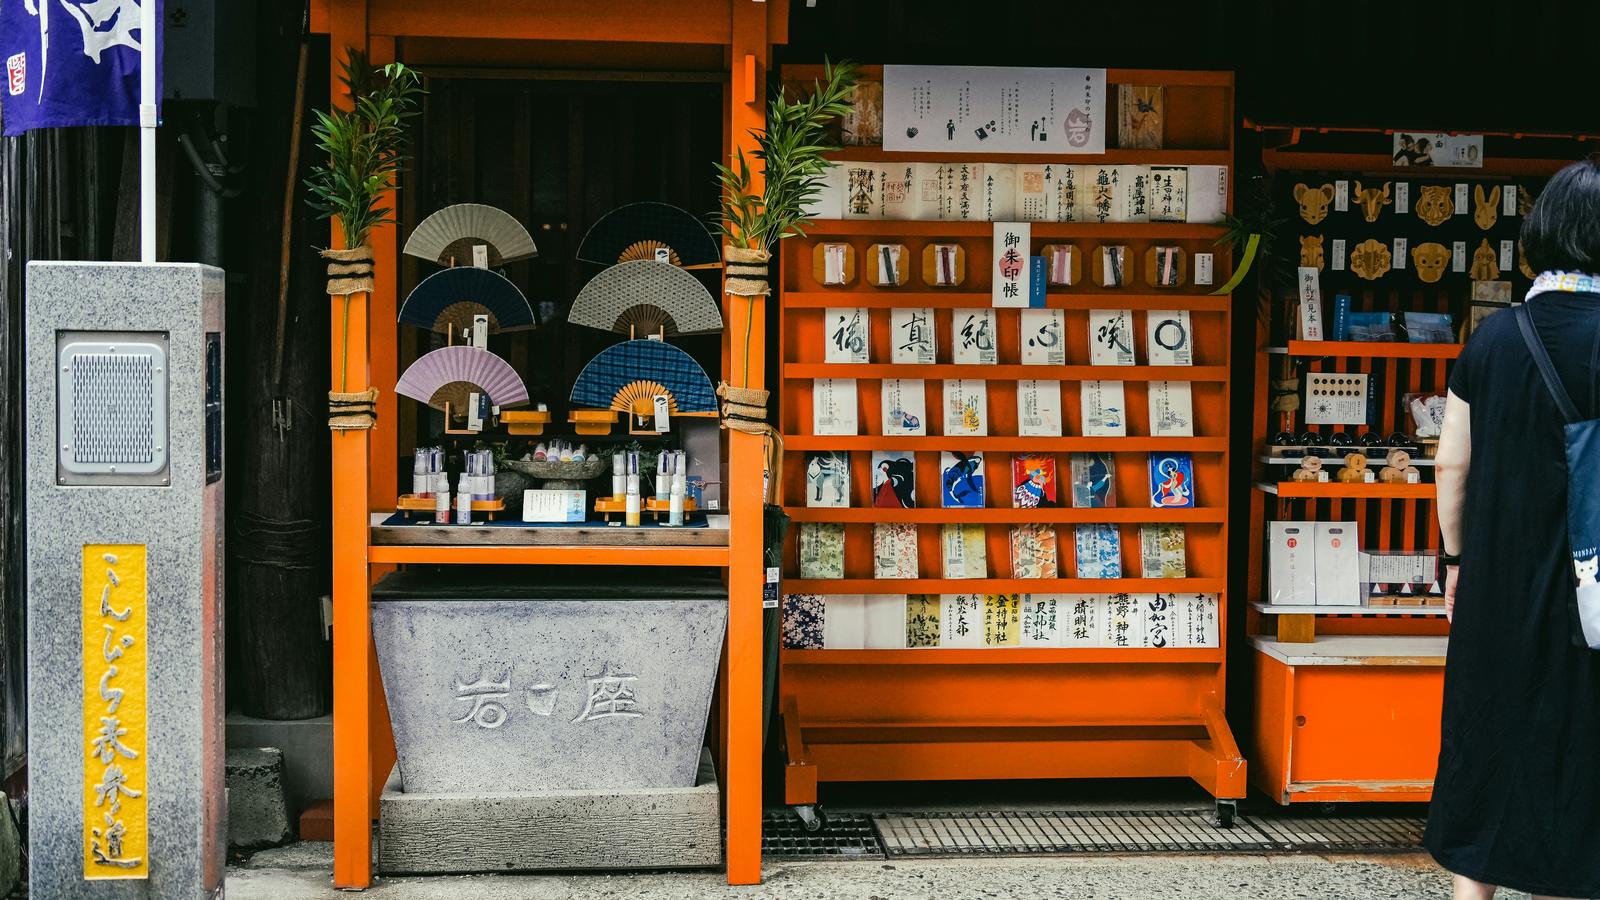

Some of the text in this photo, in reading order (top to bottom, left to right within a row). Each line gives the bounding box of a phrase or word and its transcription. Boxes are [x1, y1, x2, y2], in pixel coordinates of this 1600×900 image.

[1002, 231, 1021, 298] 御朱印帳
[898, 312, 930, 353] 真
[1572, 546, 1597, 558] MONDAY
[996, 594, 1009, 644] 金持神社
[1073, 599, 1090, 640] 晴明社
[1113, 592, 1131, 647] 熊野神社
